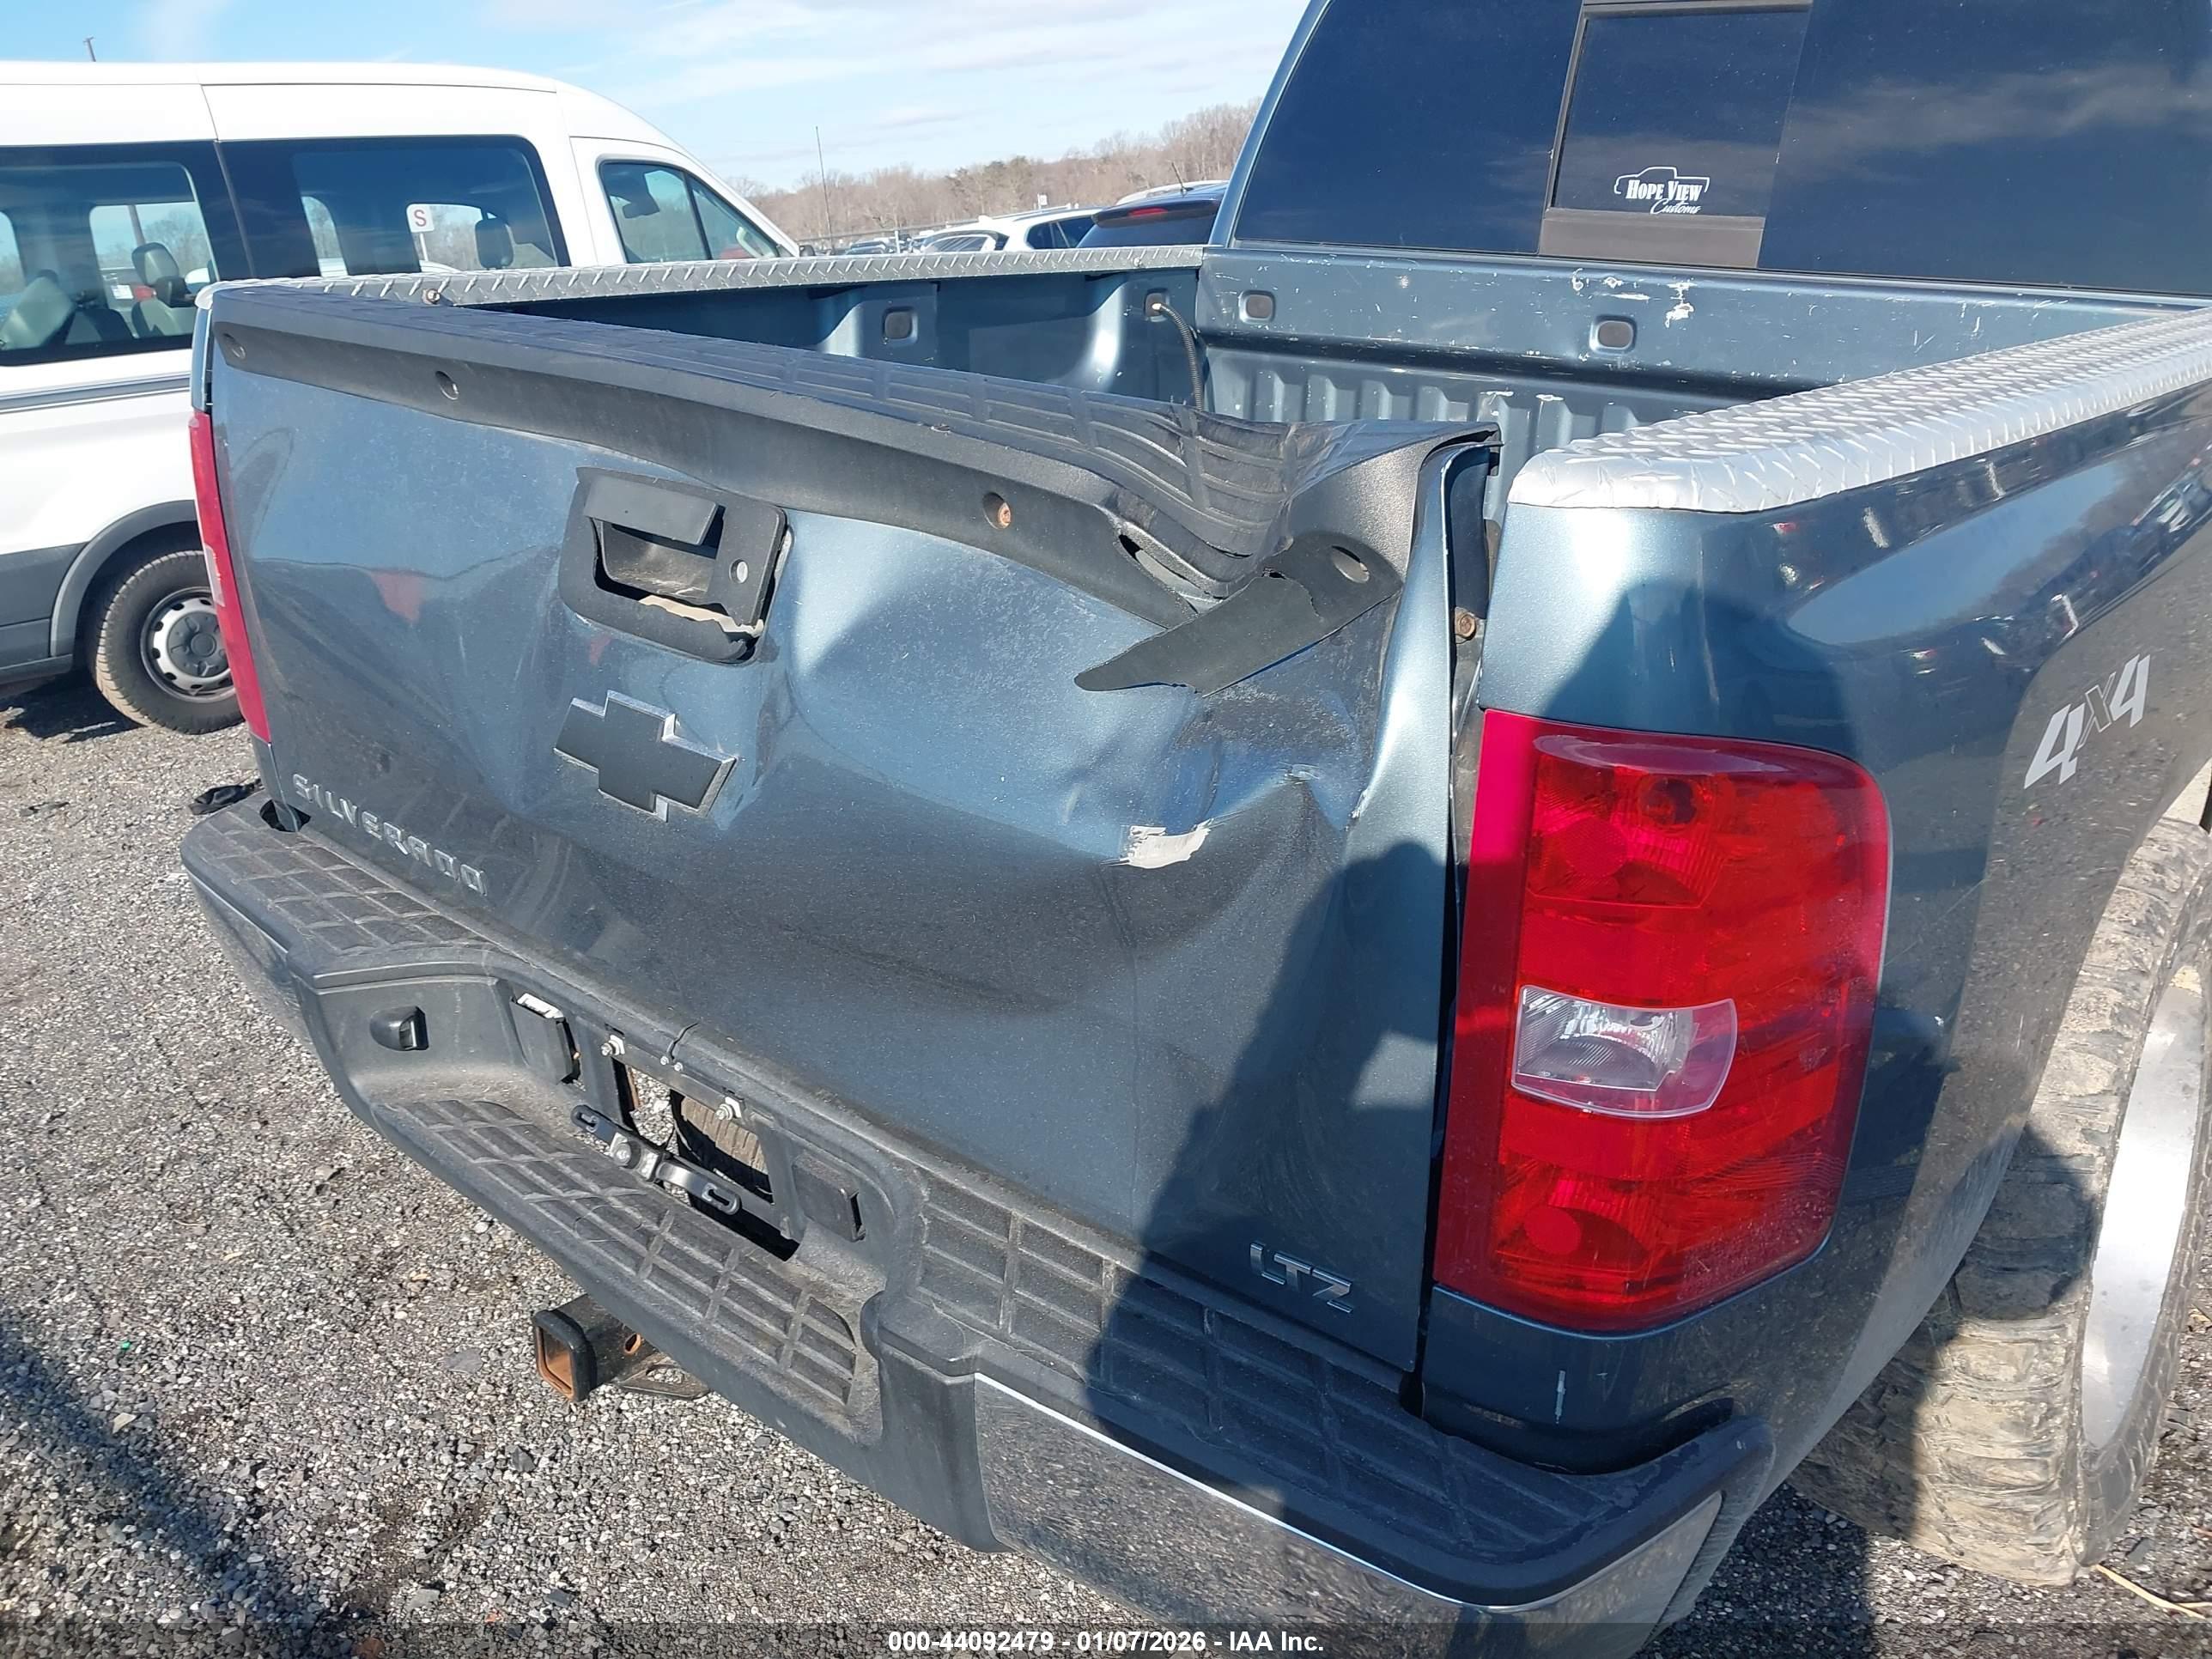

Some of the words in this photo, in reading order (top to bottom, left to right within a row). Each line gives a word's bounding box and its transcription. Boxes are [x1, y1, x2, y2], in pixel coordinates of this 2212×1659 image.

[1625, 179, 1665, 200] HOPE
[1667, 180, 1703, 202] VIEW
[1650, 198, 1702, 215] Customs
[413, 209, 427, 228] S
[292, 773, 488, 896] SILVERADO
[1249, 1242, 1353, 1313] LTZ
